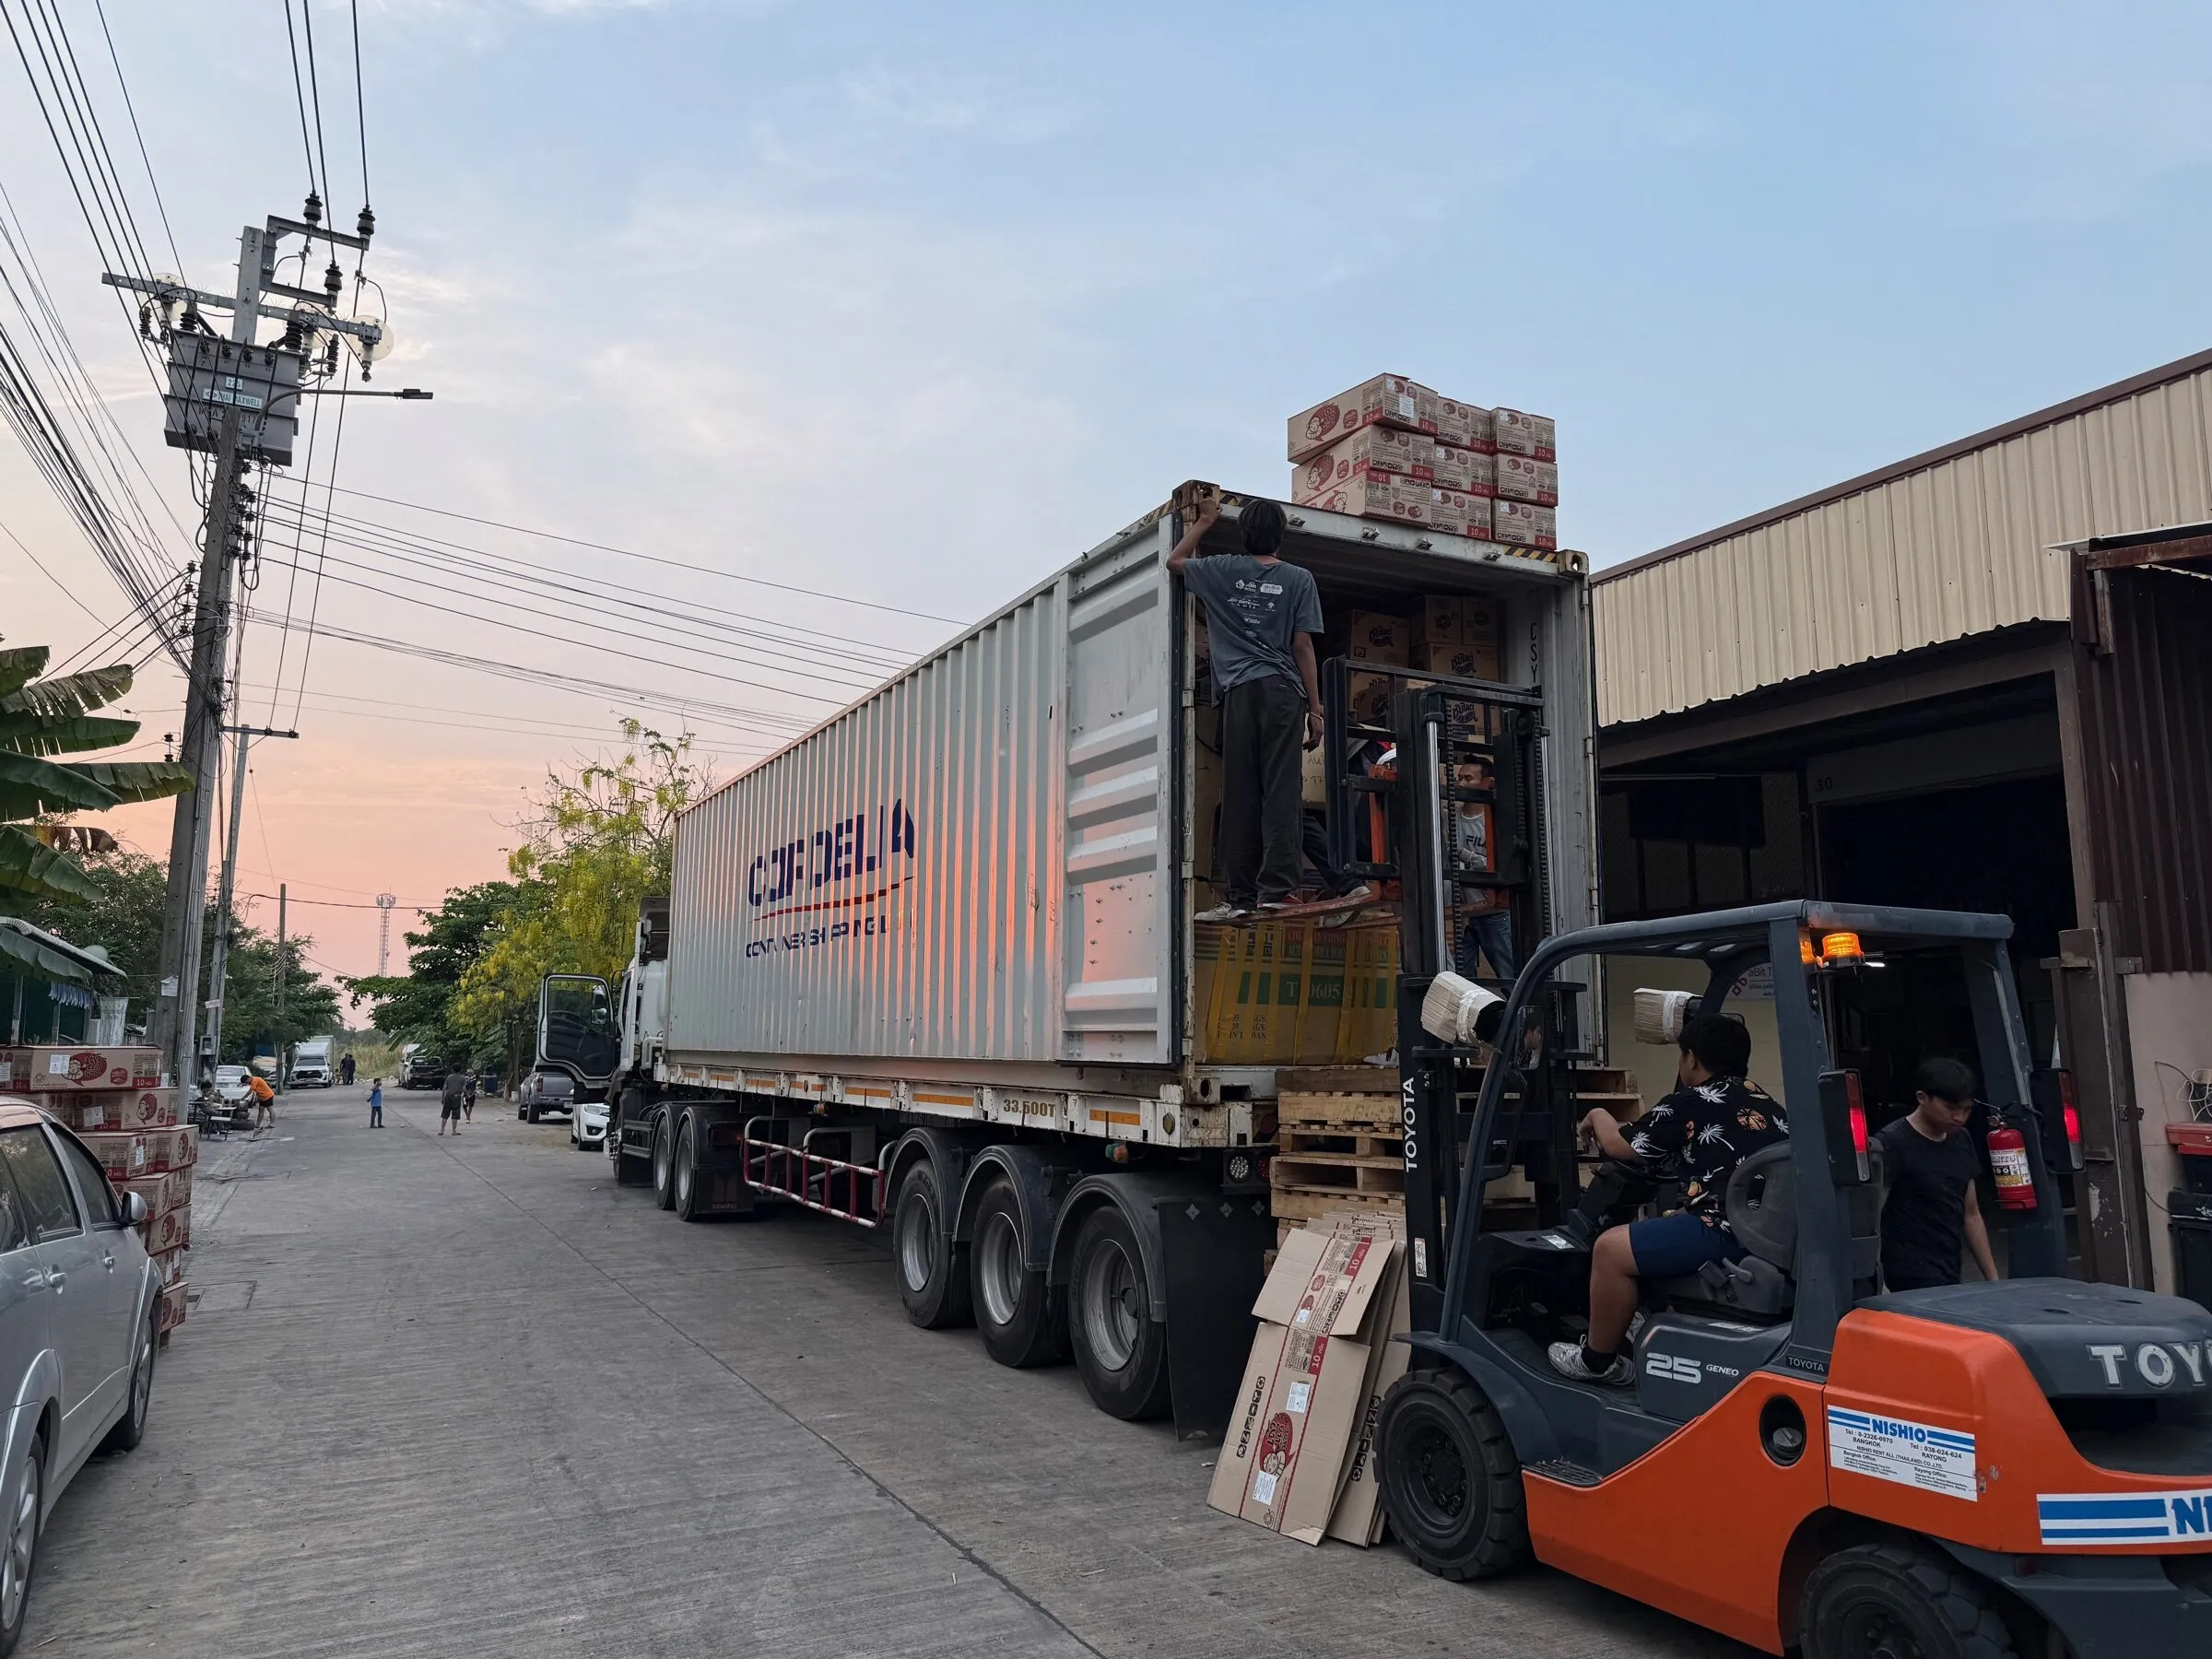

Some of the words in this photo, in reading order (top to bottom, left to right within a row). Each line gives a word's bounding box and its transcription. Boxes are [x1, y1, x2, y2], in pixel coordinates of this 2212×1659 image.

[235, 394, 261, 407] AXWELL
[746, 931, 806, 959] CONTNER
[809, 915, 875, 947] SHPPNG
[1003, 1099, 1056, 1118] 33.500T
[1403, 1077, 1418, 1173] TOYOTA
[1350, 1259, 1360, 1271] 10
[1312, 1355, 1321, 1368] 10
[1645, 1352, 1701, 1384] 25
[1787, 1357, 1825, 1372] TOYOTA
[2086, 1336, 2212, 1390] TOY
[1706, 1364, 1739, 1376] GENEO
[1872, 1418, 1926, 1443] NISHIO
[1853, 1437, 1882, 1448] BANGKOK
[1922, 1452, 1947, 1463] RAYONG
